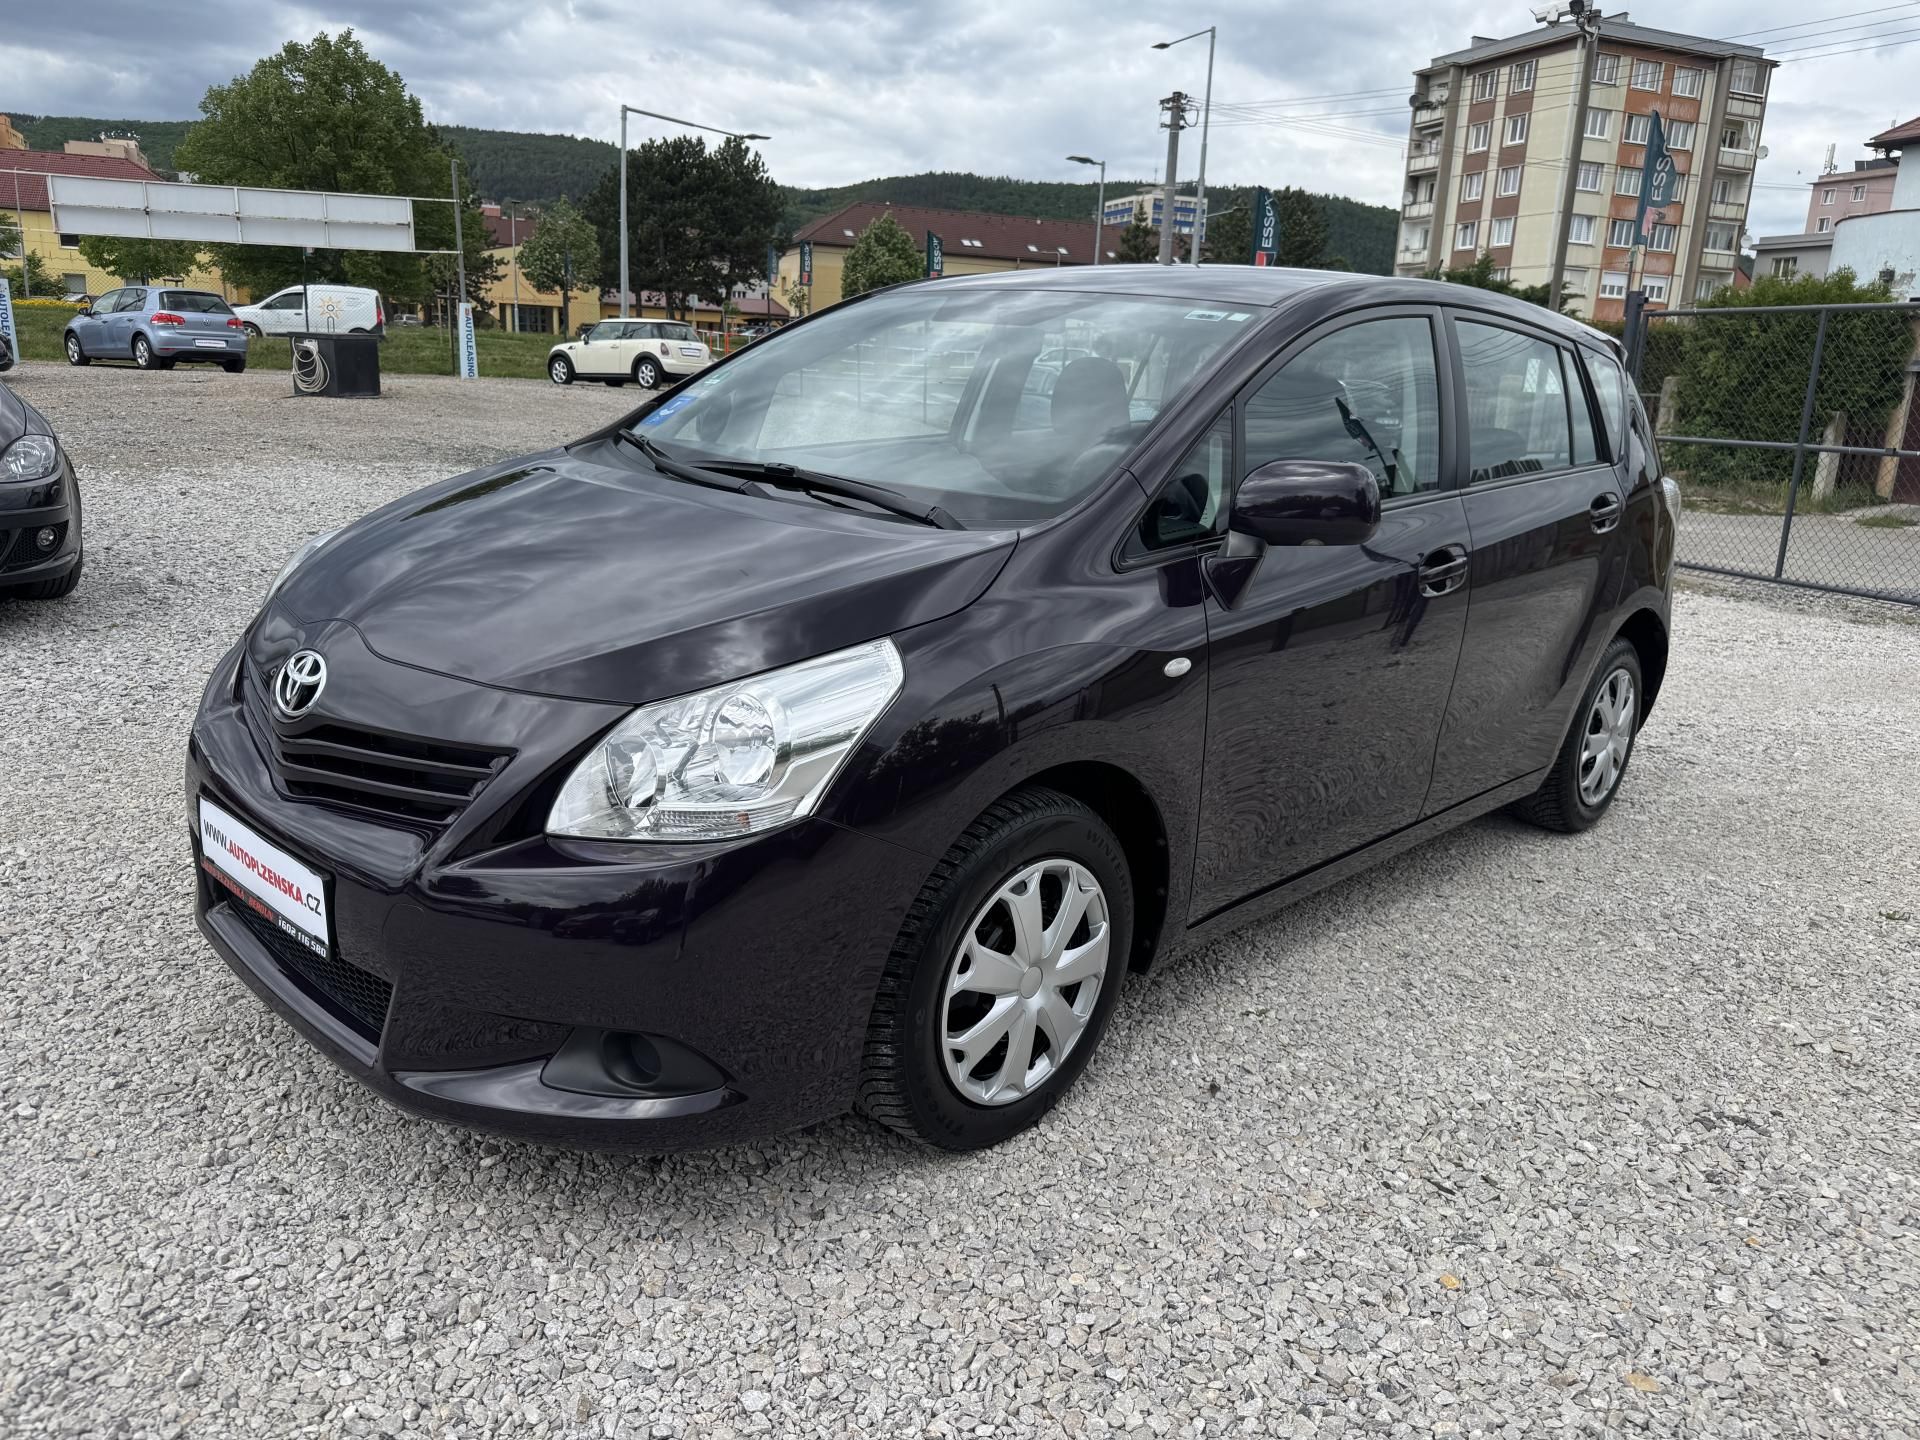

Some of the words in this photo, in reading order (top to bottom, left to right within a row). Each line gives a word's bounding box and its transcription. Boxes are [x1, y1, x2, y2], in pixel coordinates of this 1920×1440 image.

[1262, 195, 1275, 247] ESSOX
[464, 316, 475, 378] AUTOLEASING
[203, 819, 322, 916] WWW.AUTOPLZENSKA.CZ
[298, 932, 310, 948] 116
[310, 940, 327, 958] 580
